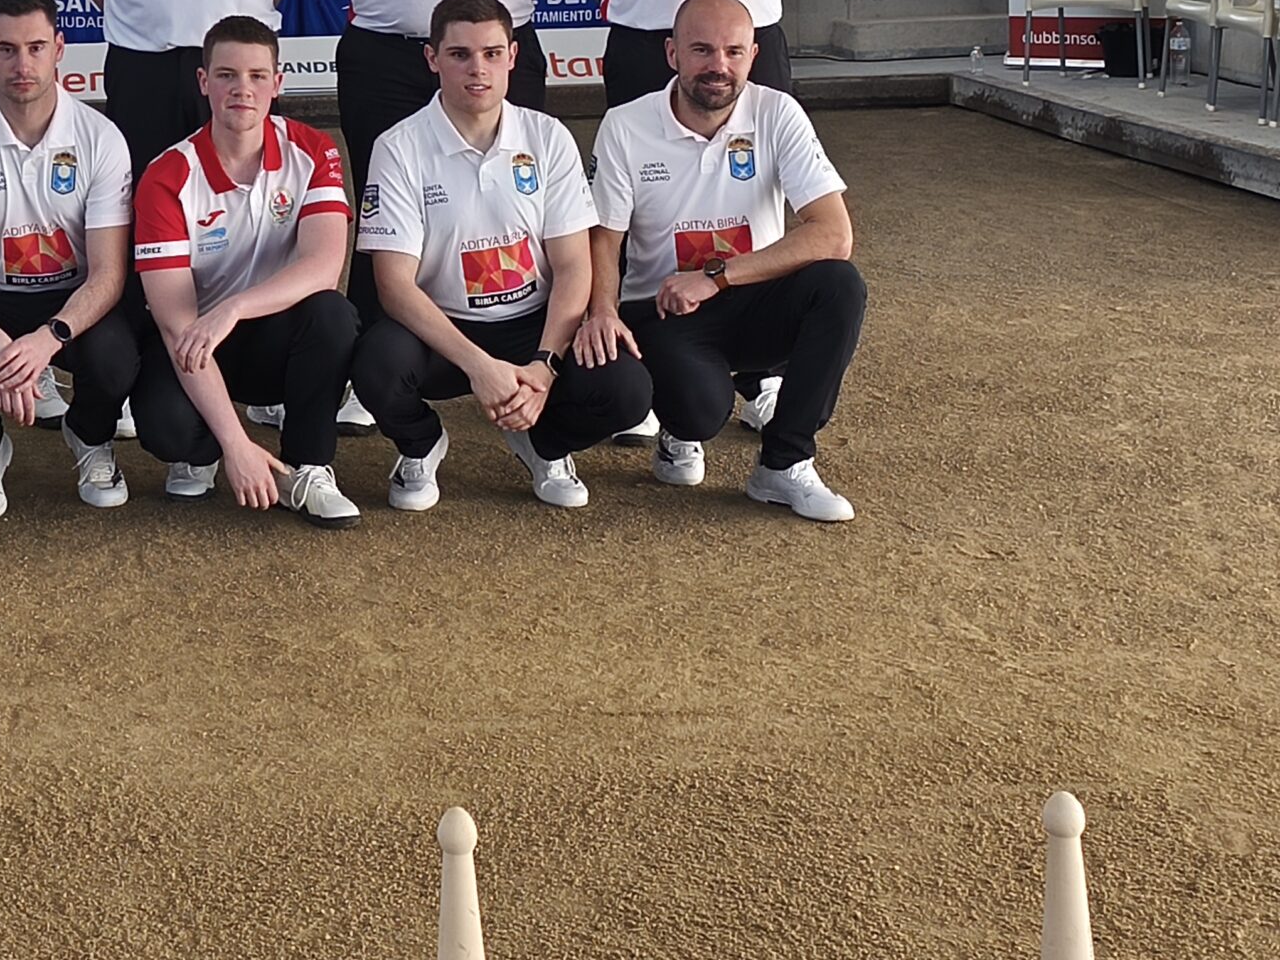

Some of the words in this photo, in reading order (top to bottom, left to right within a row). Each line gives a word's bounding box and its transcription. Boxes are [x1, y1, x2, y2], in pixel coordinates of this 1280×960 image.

[3, 223, 40, 236] ADITYA
[674, 221, 714, 232] ADITYA
[716, 215, 748, 227] BIRLA
[460, 236, 499, 251] ADITYA
[12, 275, 37, 285] BIRLA
[474, 296, 500, 306] BIRLA
[500, 285, 533, 303] CARBON
